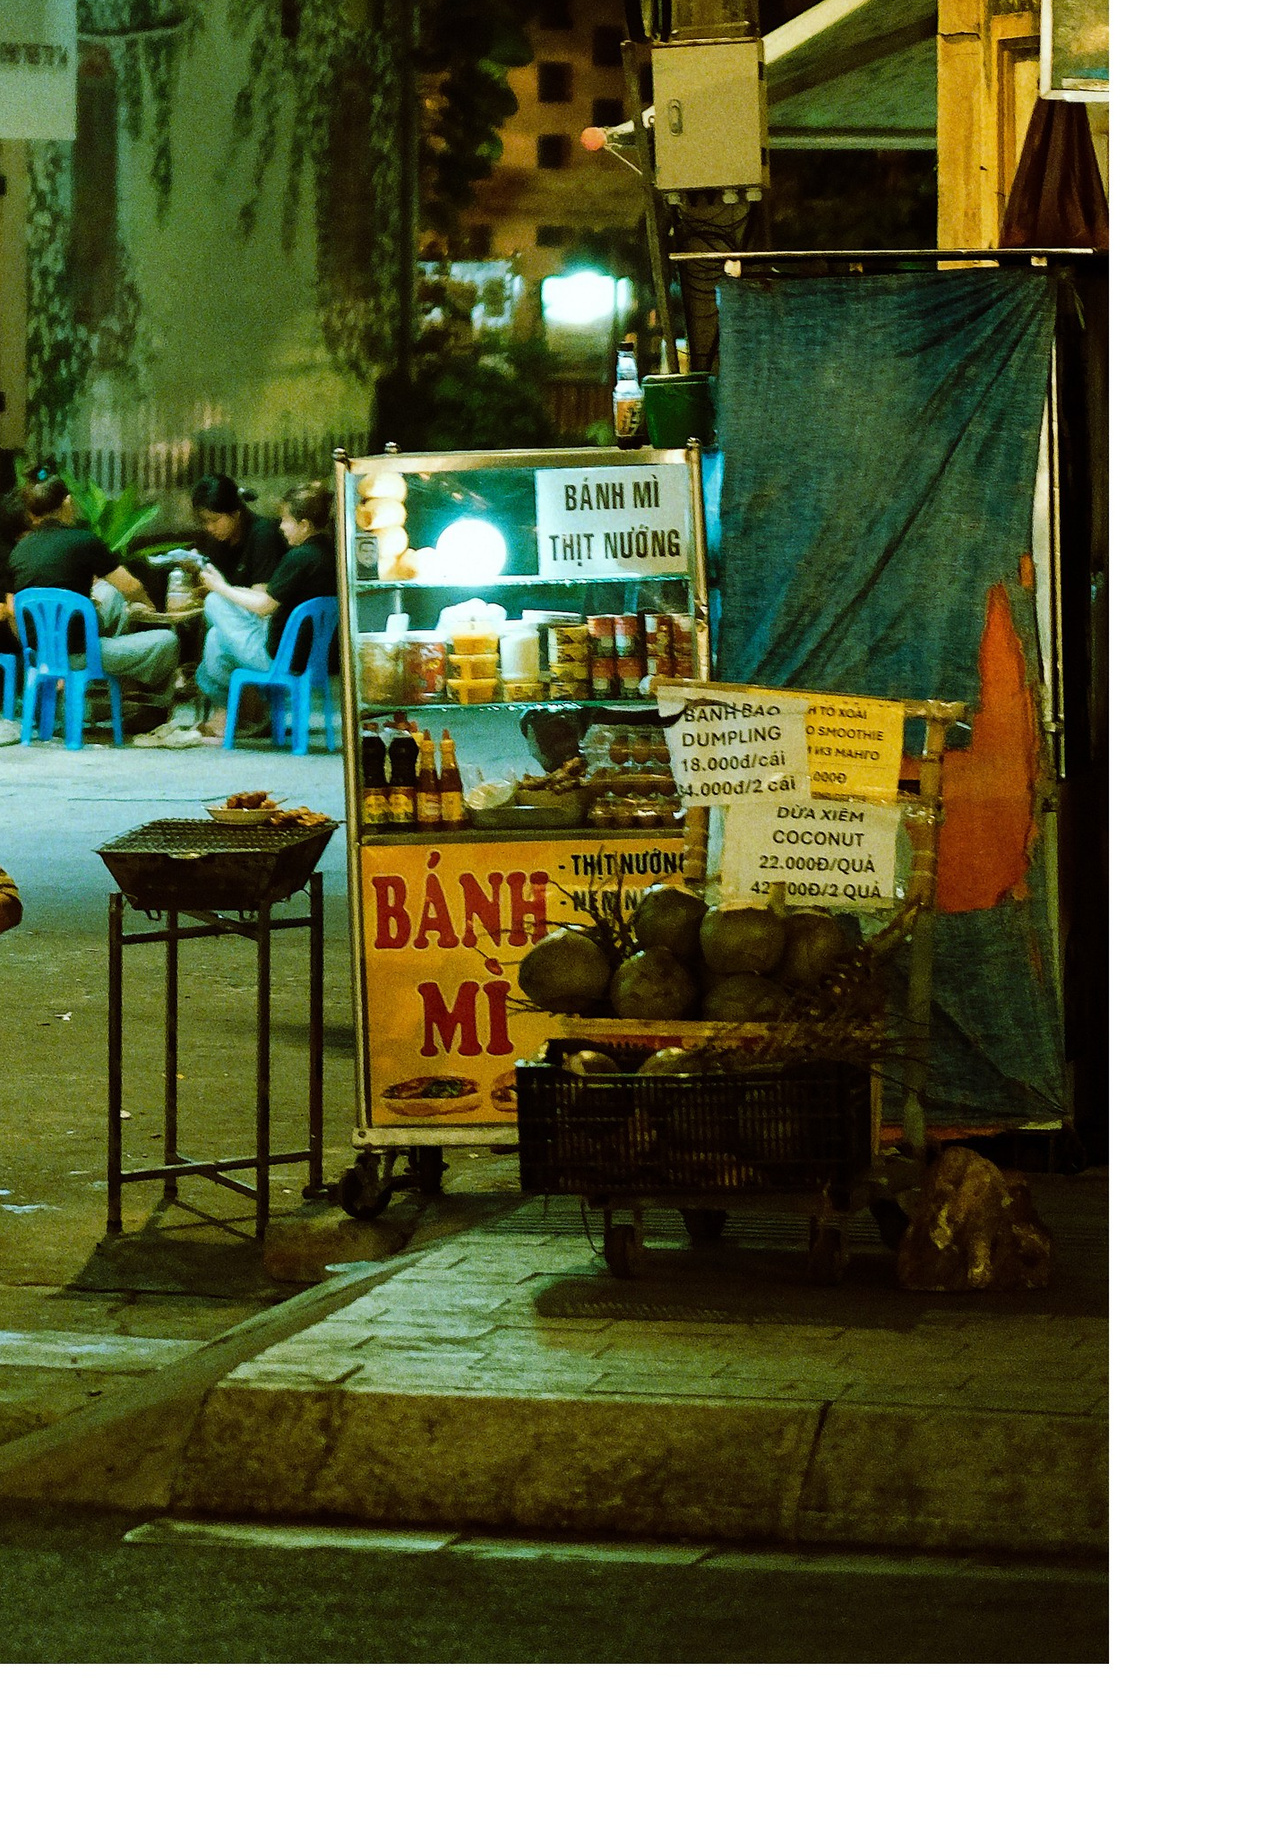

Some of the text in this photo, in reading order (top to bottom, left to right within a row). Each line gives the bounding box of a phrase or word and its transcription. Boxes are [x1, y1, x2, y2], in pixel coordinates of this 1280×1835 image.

[563, 473, 661, 511] BÁNH MÌ
[548, 532, 595, 567] THỊT
[682, 725, 782, 747] DUMPLING
[817, 725, 884, 741] SMOOTHIE
[767, 774, 796, 792] cái
[810, 770, 848, 785] .000Đ
[819, 806, 865, 823] XIÊM
[772, 829, 865, 847] COCONUT
[570, 853, 616, 880] THỊT
[750, 880, 839, 898] 4200Đ/2
[372, 850, 549, 950] BÁNH
[417, 958, 515, 1058] MÌ
